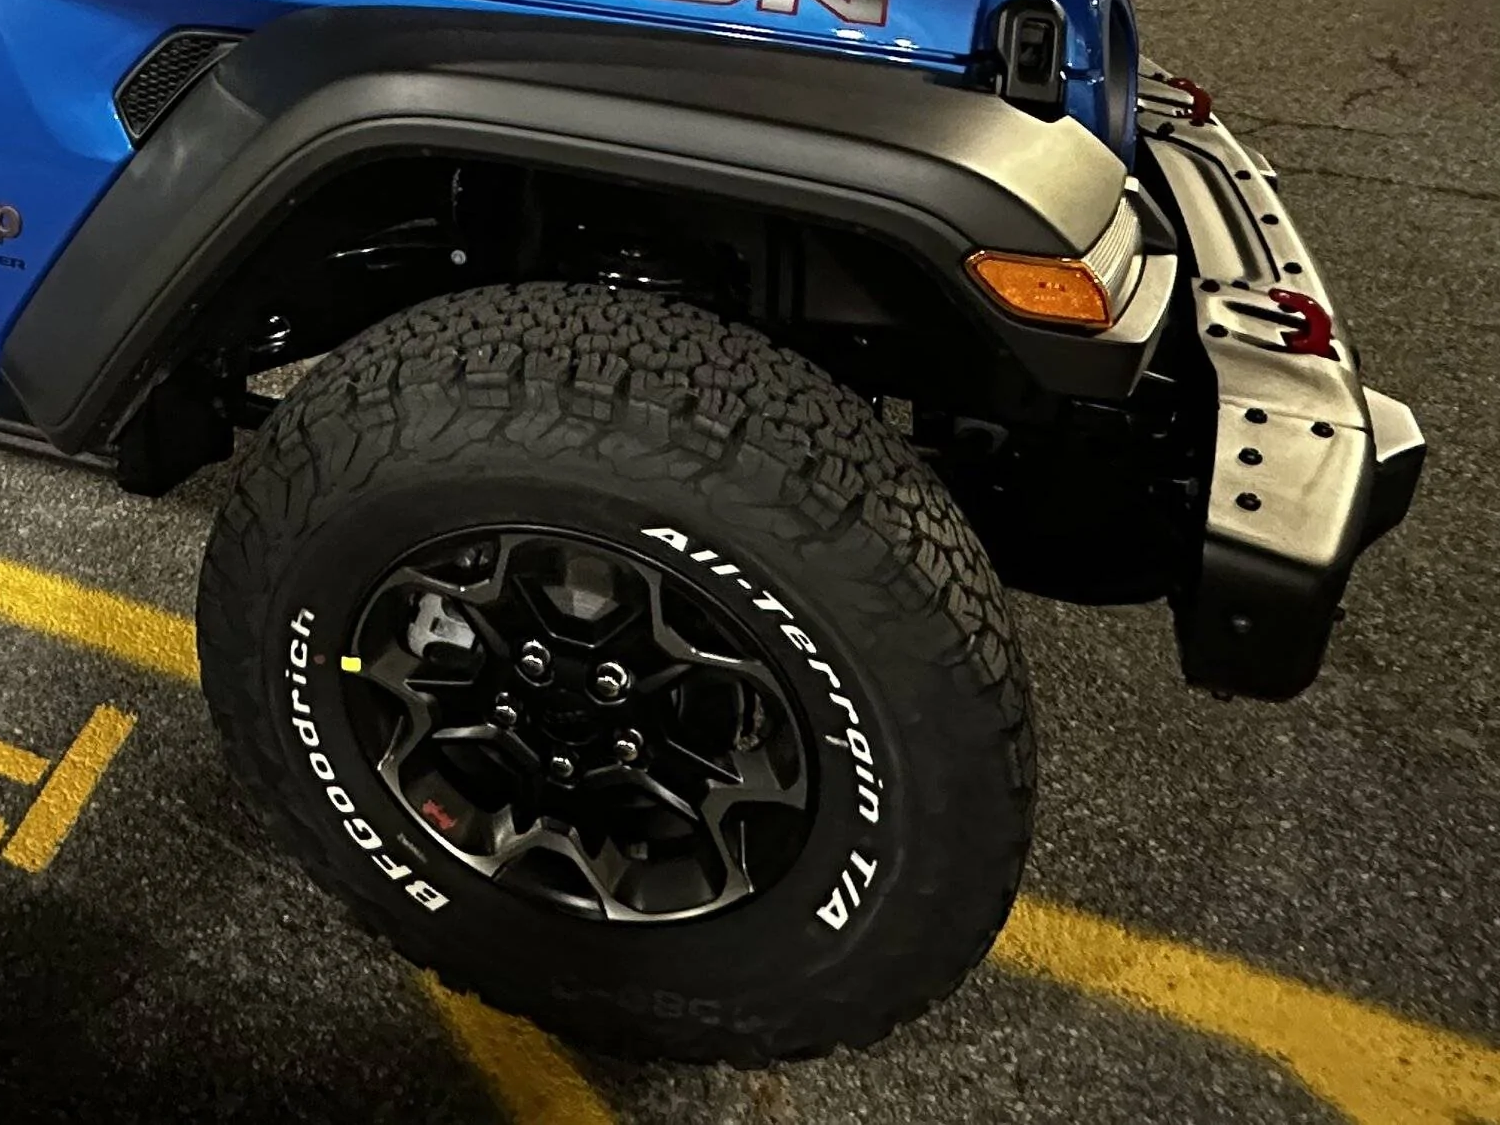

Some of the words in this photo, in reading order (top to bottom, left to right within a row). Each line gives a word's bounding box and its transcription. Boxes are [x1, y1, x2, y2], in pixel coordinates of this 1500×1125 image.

[285, 607, 450, 912] BFGoodrich
[640, 526, 884, 825] All-Terrain
[816, 849, 878, 931] T/A
